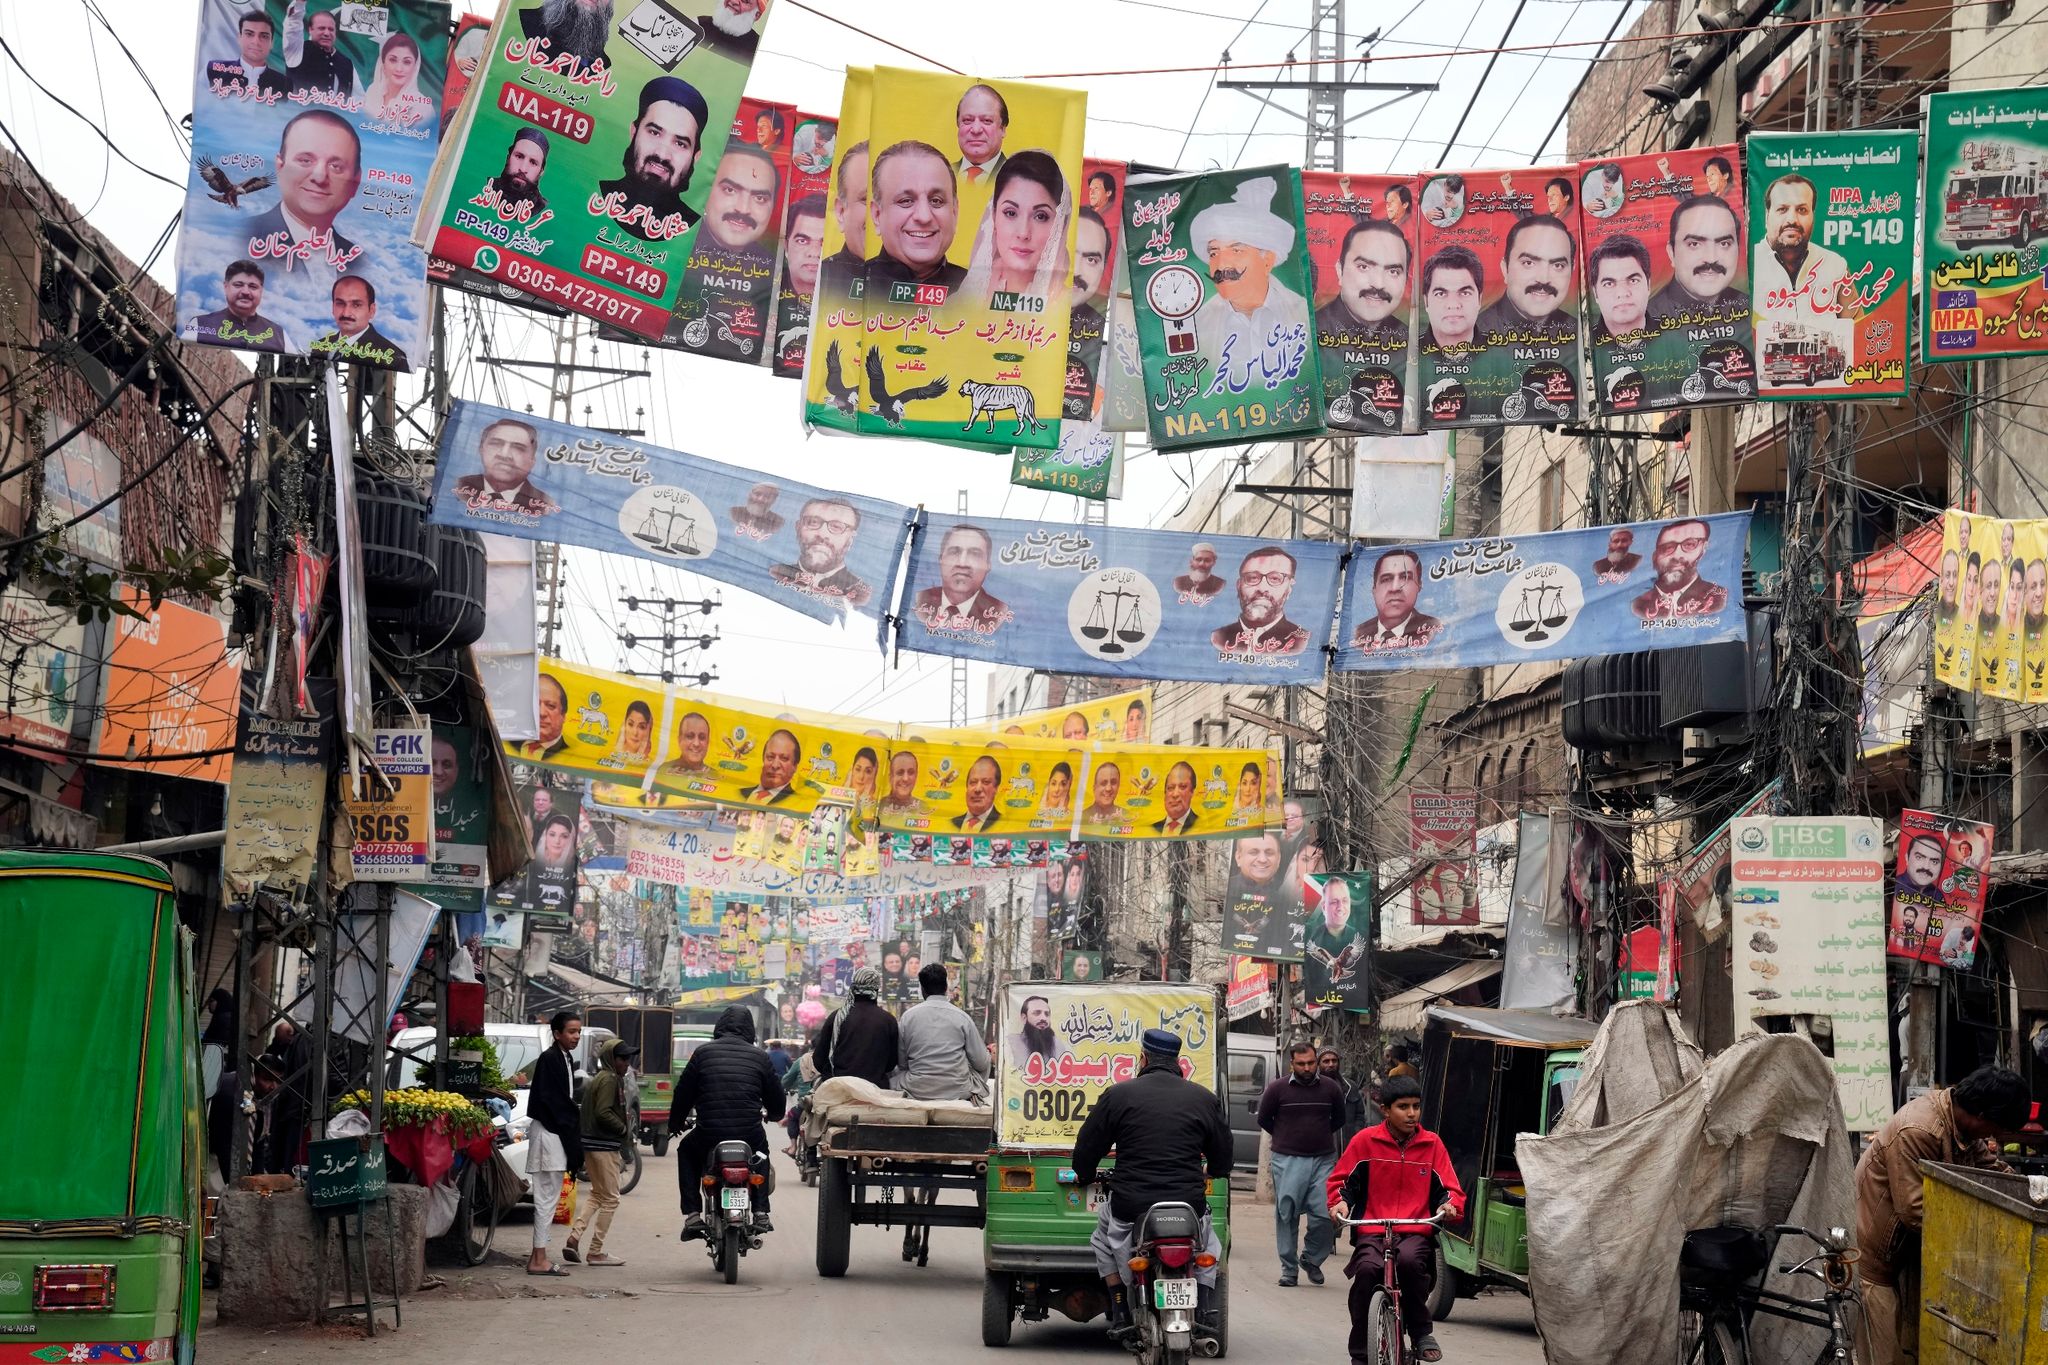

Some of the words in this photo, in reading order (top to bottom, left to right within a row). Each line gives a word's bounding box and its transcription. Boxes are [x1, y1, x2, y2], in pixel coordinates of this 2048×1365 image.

[629, 14, 674, 39] کتاب
[504, 36, 554, 68] خان
[543, 51, 583, 84] احمد
[574, 58, 618, 98] راشد
[401, 94, 433, 106] NA-119
[504, 86, 590, 141] NA-119
[1948, 105, 1996, 129] قیادت
[1996, 106, 2037, 129] پسند
[1765, 148, 1812, 171] قیادت
[1812, 149, 1853, 172] پسند
[1854, 145, 1901, 165] انصاف
[368, 169, 413, 186] PP-149
[468, 178, 503, 210] اللہ
[1830, 187, 1862, 204] MPA
[588, 191, 628, 221] خان
[455, 210, 509, 243] PP-149
[1823, 218, 1904, 246] PP-149
[248, 231, 292, 261] خان
[585, 250, 663, 295] PP-149
[742, 261, 771, 278] میاں
[1936, 252, 1982, 287] انجن
[1980, 252, 2018, 284] فائر
[703, 273, 753, 294] NA-119
[1766, 256, 1824, 310] کمبوہ
[1810, 260, 1874, 315] مبین
[1848, 267, 1895, 309] محمد
[506, 260, 643, 326] 0305-4727977
[895, 285, 946, 305] PP-149
[993, 295, 1045, 313] NA-119
[1984, 287, 2028, 336] کمبوہ
[866, 313, 908, 334] خان
[1659, 312, 1691, 331] فاروق
[1692, 308, 1722, 327] شہزاد
[1724, 306, 1750, 324] میاں
[1934, 309, 1980, 331] MPA
[975, 317, 1015, 345] شریف
[1073, 325, 1100, 339] میاں
[1267, 322, 1307, 348] چوہدری
[1318, 331, 1351, 347] فاروق
[1487, 329, 1518, 346] فاروق
[1519, 329, 1549, 347] شہزاد
[1550, 329, 1576, 345] میاں
[1595, 333, 1613, 347] خان
[1615, 328, 1661, 345] عبدالکریم
[1688, 325, 1735, 342] NA-119
[1351, 333, 1382, 351] شہزاد
[1381, 336, 1407, 351] میاں
[1421, 343, 1441, 356] خان
[1442, 341, 1488, 356] عبدالکریم
[1279, 342, 1307, 382] محمد
[1344, 351, 1391, 366] NA-119
[1513, 348, 1561, 361] NA-119
[1611, 352, 1645, 364] PP-150
[895, 358, 928, 373] عقاب
[995, 364, 1022, 381] شیر
[1202, 332, 1239, 399] گجر
[1228, 349, 1288, 393] الیاس
[1435, 364, 1470, 375] PP-150
[1844, 360, 1879, 386] انجن
[1876, 360, 1904, 384] فائر
[1164, 402, 1268, 438] NA-119
[1020, 465, 1079, 489] NA-119
[1049, 553, 1101, 573] جماعت
[1474, 556, 1524, 576] جماعت
[1641, 619, 1678, 630] PP-149
[1218, 652, 1256, 665] PP-149
[167, 672, 200, 712] Rehan
[149, 711, 181, 750] Mobile
[182, 718, 208, 752] Shop
[389, 765, 425, 774] CAMPUS
[1414, 798, 1447, 808] SAGAR
[1416, 809, 1435, 818] ICE
[1436, 809, 1475, 818] CREAM
[1778, 827, 1835, 845] HBC
[630, 849, 650, 862] 0321
[1780, 846, 1835, 856] FOODS
[627, 862, 649, 876] 0324
[1681, 851, 1718, 889] Haram
[1811, 886, 1849, 904] کوفتہ
[1853, 887, 1883, 906] چکن
[1896, 889, 1921, 906] فاروق
[1928, 926, 1943, 938] 119
[1856, 934, 1885, 951] چکن
[1814, 961, 1845, 976] کباب
[1315, 990, 1344, 1004] عقاب
[1790, 985, 1822, 1000] کباب
[1826, 986, 1855, 1002] سیخ
[1858, 986, 1887, 1003] چکن
[1022, 1050, 1111, 1087] بیورو
[1844, 1096, 1889, 1126] یہاں
[314, 1154, 358, 1176] صدقہ
[729, 1199, 745, 1207] 5315
[1166, 1283, 1183, 1294] LEM
[1166, 1294, 1191, 1306] 6357
[16, 1324, 36, 1333] NAR
